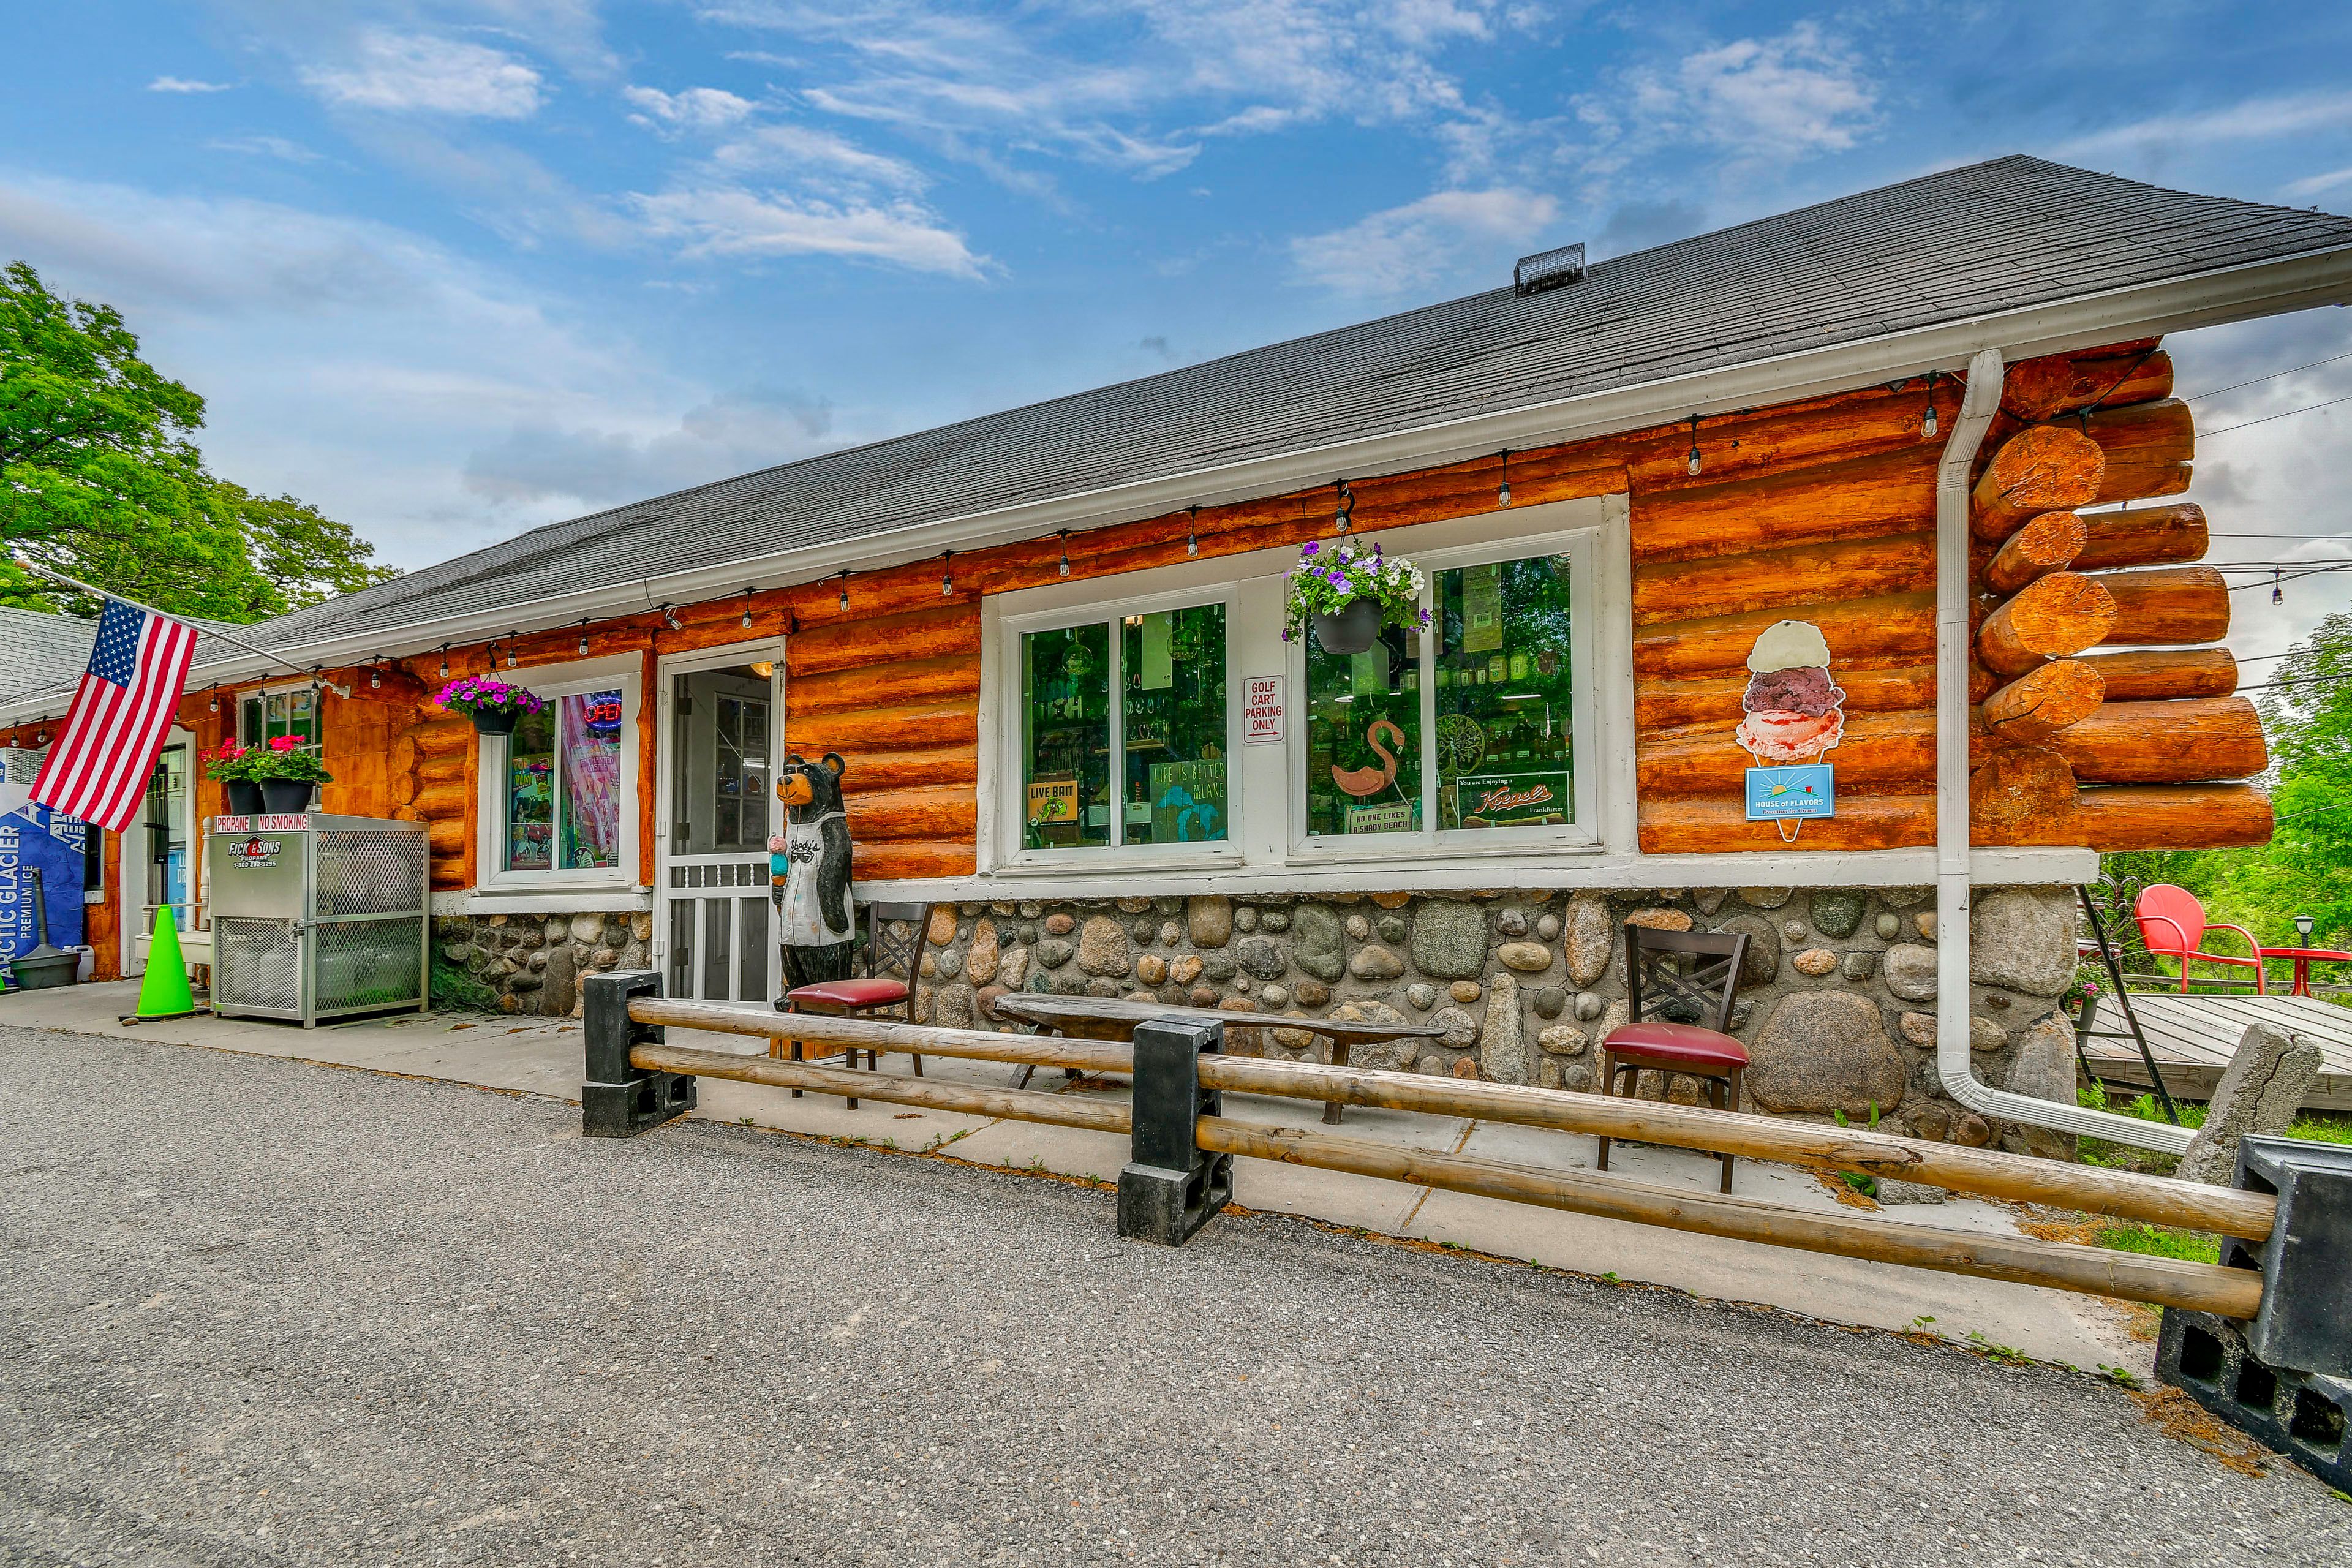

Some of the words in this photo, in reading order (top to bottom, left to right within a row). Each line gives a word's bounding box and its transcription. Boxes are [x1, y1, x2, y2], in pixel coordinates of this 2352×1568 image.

[1251, 681, 1276, 693] GOLF
[1251, 693, 1276, 706] CART
[1246, 706, 1282, 719] PARKING
[1253, 718, 1275, 731] ONLY
[1154, 767, 1172, 783] LIFE
[1178, 766, 1187, 781] IS
[1192, 762, 1224, 780] BETTER
[1031, 787, 1050, 799] LIVE
[1052, 785, 1074, 797] BAIT
[1201, 783, 1224, 799] LAKE
[1474, 784, 1553, 814] Koegel's
[1384, 811, 1405, 820] LIKES
[218, 816, 249, 831] PROPANE
[259, 815, 270, 830] NO
[271, 815, 307, 829] SMOKING
[1360, 823, 1381, 832] SHADY
[1384, 821, 1407, 829] BEACH
[229, 842, 251, 855] FICK
[251, 843, 257, 854] &
[257, 841, 281, 854] SONS
[791, 839, 821, 851] Shady's
[0, 826, 20, 903] GLACIER
[22, 865, 34, 882] ICE
[20, 888, 33, 938] PREMIUM
[0, 910, 17, 978] ARCTIC
